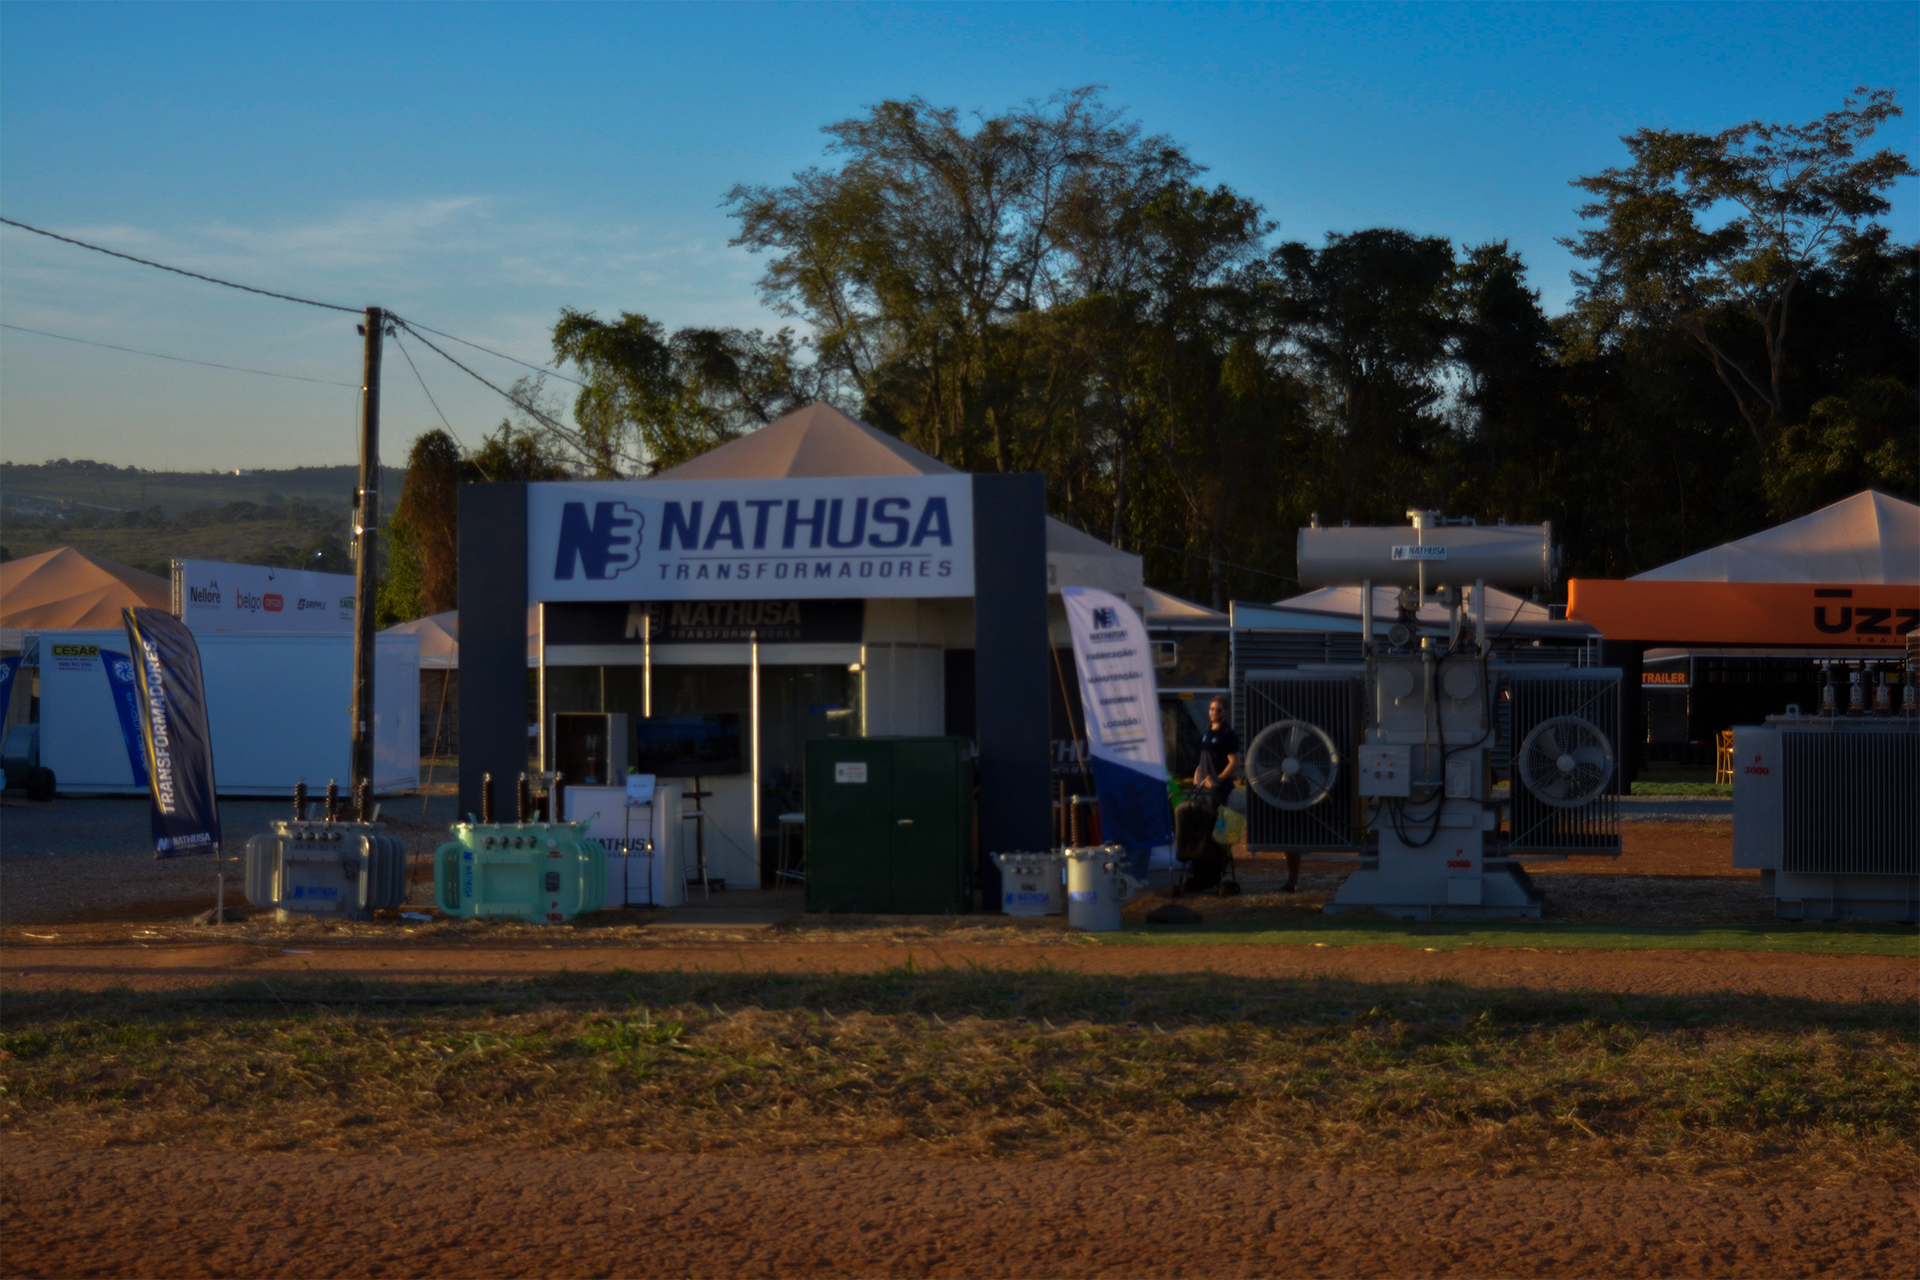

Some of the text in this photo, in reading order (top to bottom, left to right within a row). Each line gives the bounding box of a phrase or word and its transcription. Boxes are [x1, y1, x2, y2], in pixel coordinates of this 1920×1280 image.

[659, 497, 953, 551] NATHUSA
[1408, 546, 1445, 555] NATHUSA
[659, 560, 952, 580] TRANSFORMADORES
[190, 586, 221, 603] Nellore
[237, 587, 282, 613] belgo cercas
[306, 600, 326, 610] GRIPPLE
[670, 601, 800, 627] NATHUSA
[670, 628, 800, 639] TRANSFORMADORES
[1089, 630, 1126, 641] NATHUSA
[53, 645, 98, 656] CESAR
[1086, 649, 1134, 661] FABRICAÇÃO
[1087, 671, 1140, 684] MANUTENÇÃO
[1641, 672, 1686, 684] TRAILER
[1099, 695, 1135, 706] REFORMA
[143, 640, 176, 814] TRANSFORMADORES
[1103, 716, 1138, 729] LOCAÇÃO
[1754, 755, 1762, 764] P
[1744, 766, 1770, 775] 3000
[172, 832, 211, 846] NATHUSA
[1456, 848, 1463, 857] P
[1446, 860, 1471, 869] 5000
[465, 865, 473, 898] NATHUSA
[551, 901, 559, 909] P
[545, 913, 563, 922] 150
